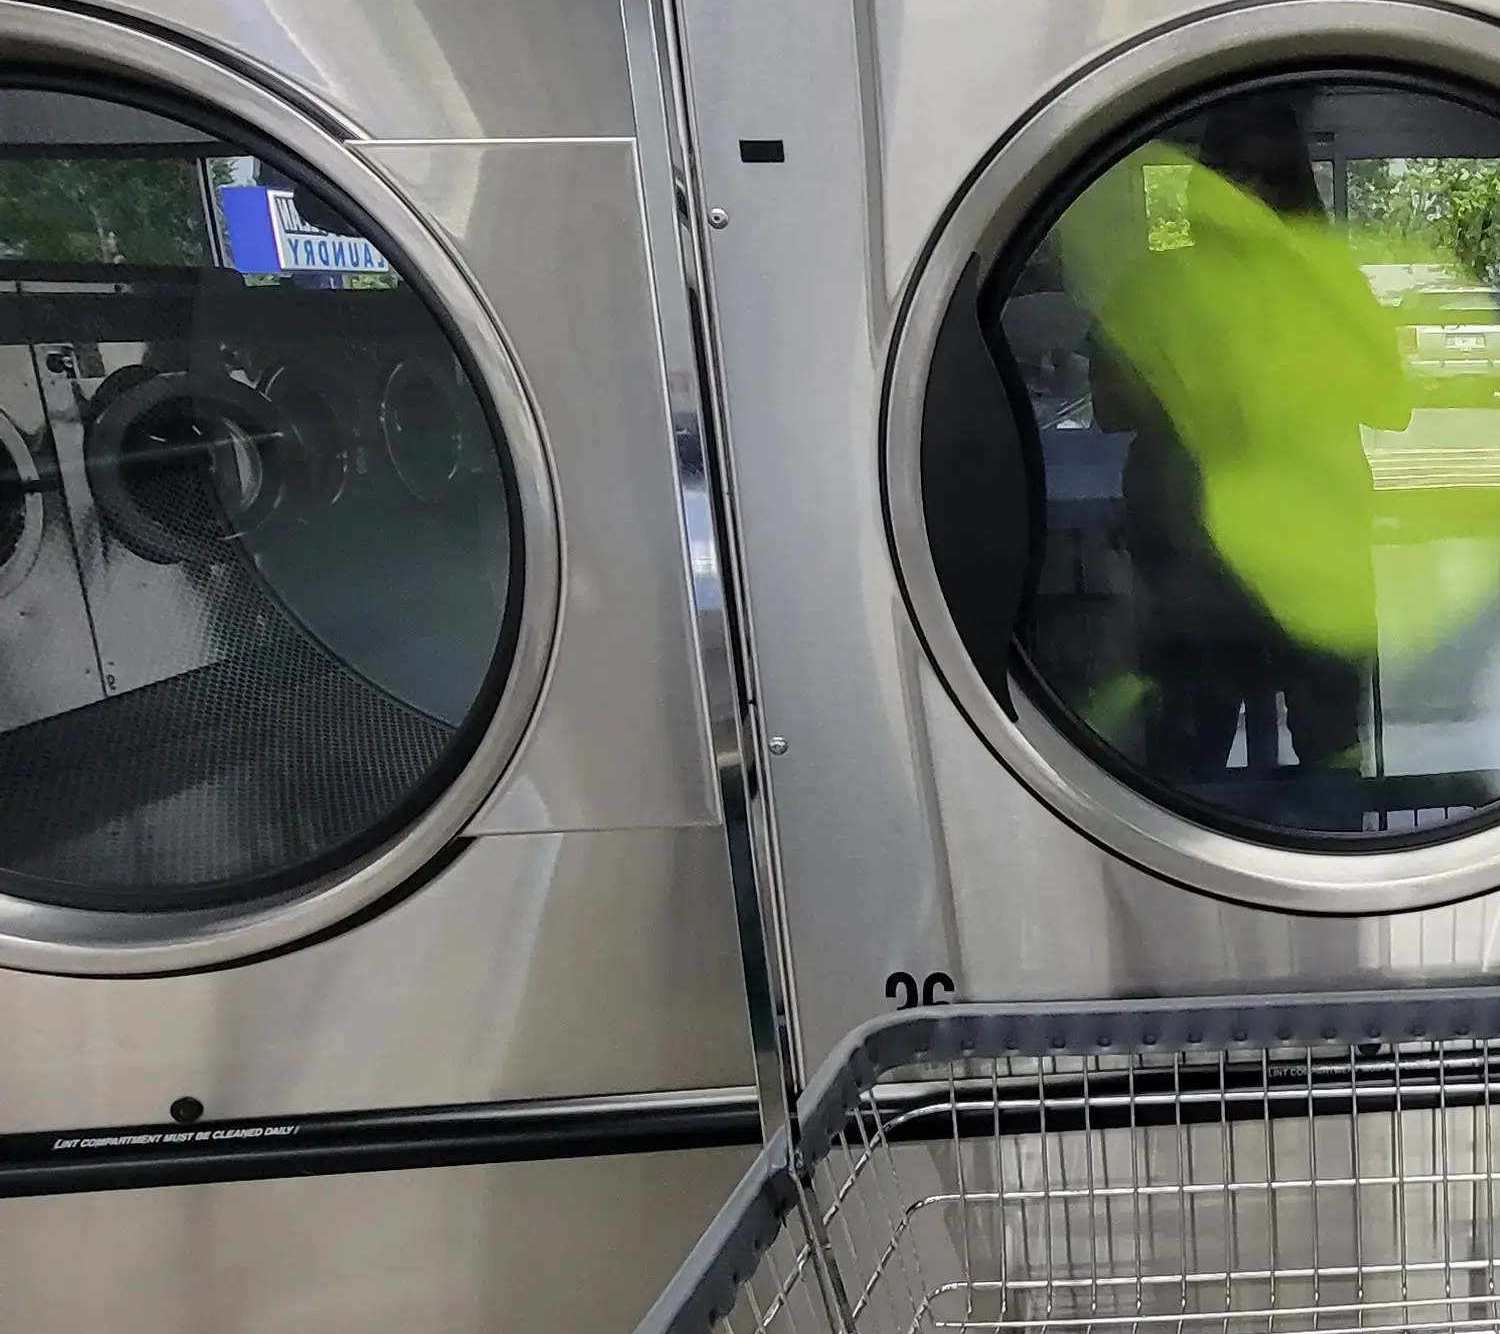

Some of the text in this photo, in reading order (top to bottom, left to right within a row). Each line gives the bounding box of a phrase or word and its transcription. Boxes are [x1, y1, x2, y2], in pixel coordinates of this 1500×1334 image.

[53, 1137, 80, 1150] LINT
[80, 1134, 161, 1148] COMPARTMENT
[162, 1131, 194, 1144] MUST
[195, 1130, 210, 1141] BE
[211, 1126, 263, 1140] CLEANED
[264, 1125, 293, 1137] DAILY
